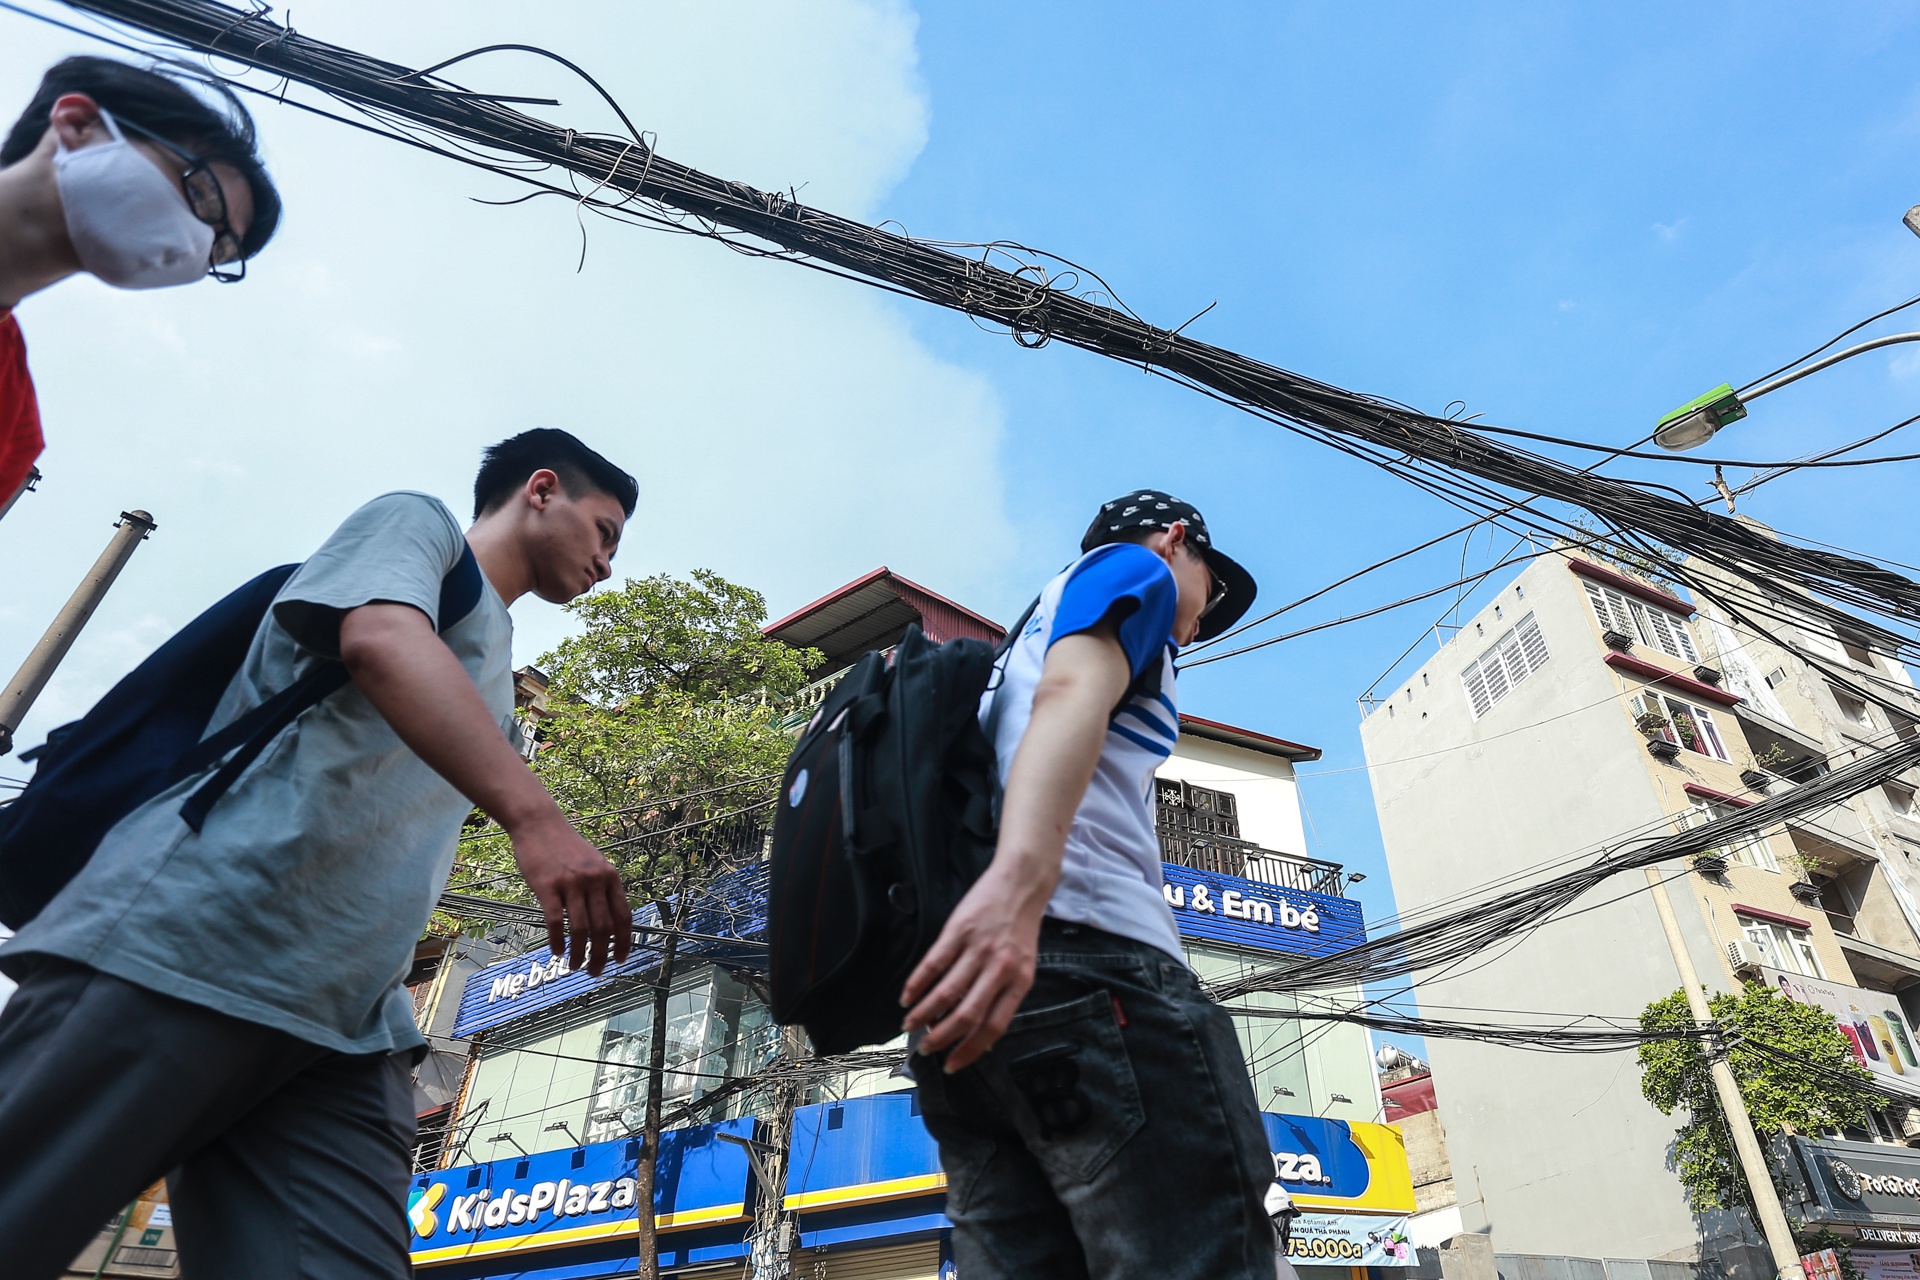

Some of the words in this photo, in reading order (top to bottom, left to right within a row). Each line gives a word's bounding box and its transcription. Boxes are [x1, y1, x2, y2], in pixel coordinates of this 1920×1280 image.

[1191, 884, 1216, 913] &
[1222, 890, 1274, 925] Em
[1280, 898, 1320, 933] bé
[488, 973, 527, 1003] Mẹ
[446, 1178, 638, 1233] KidsPlaza
